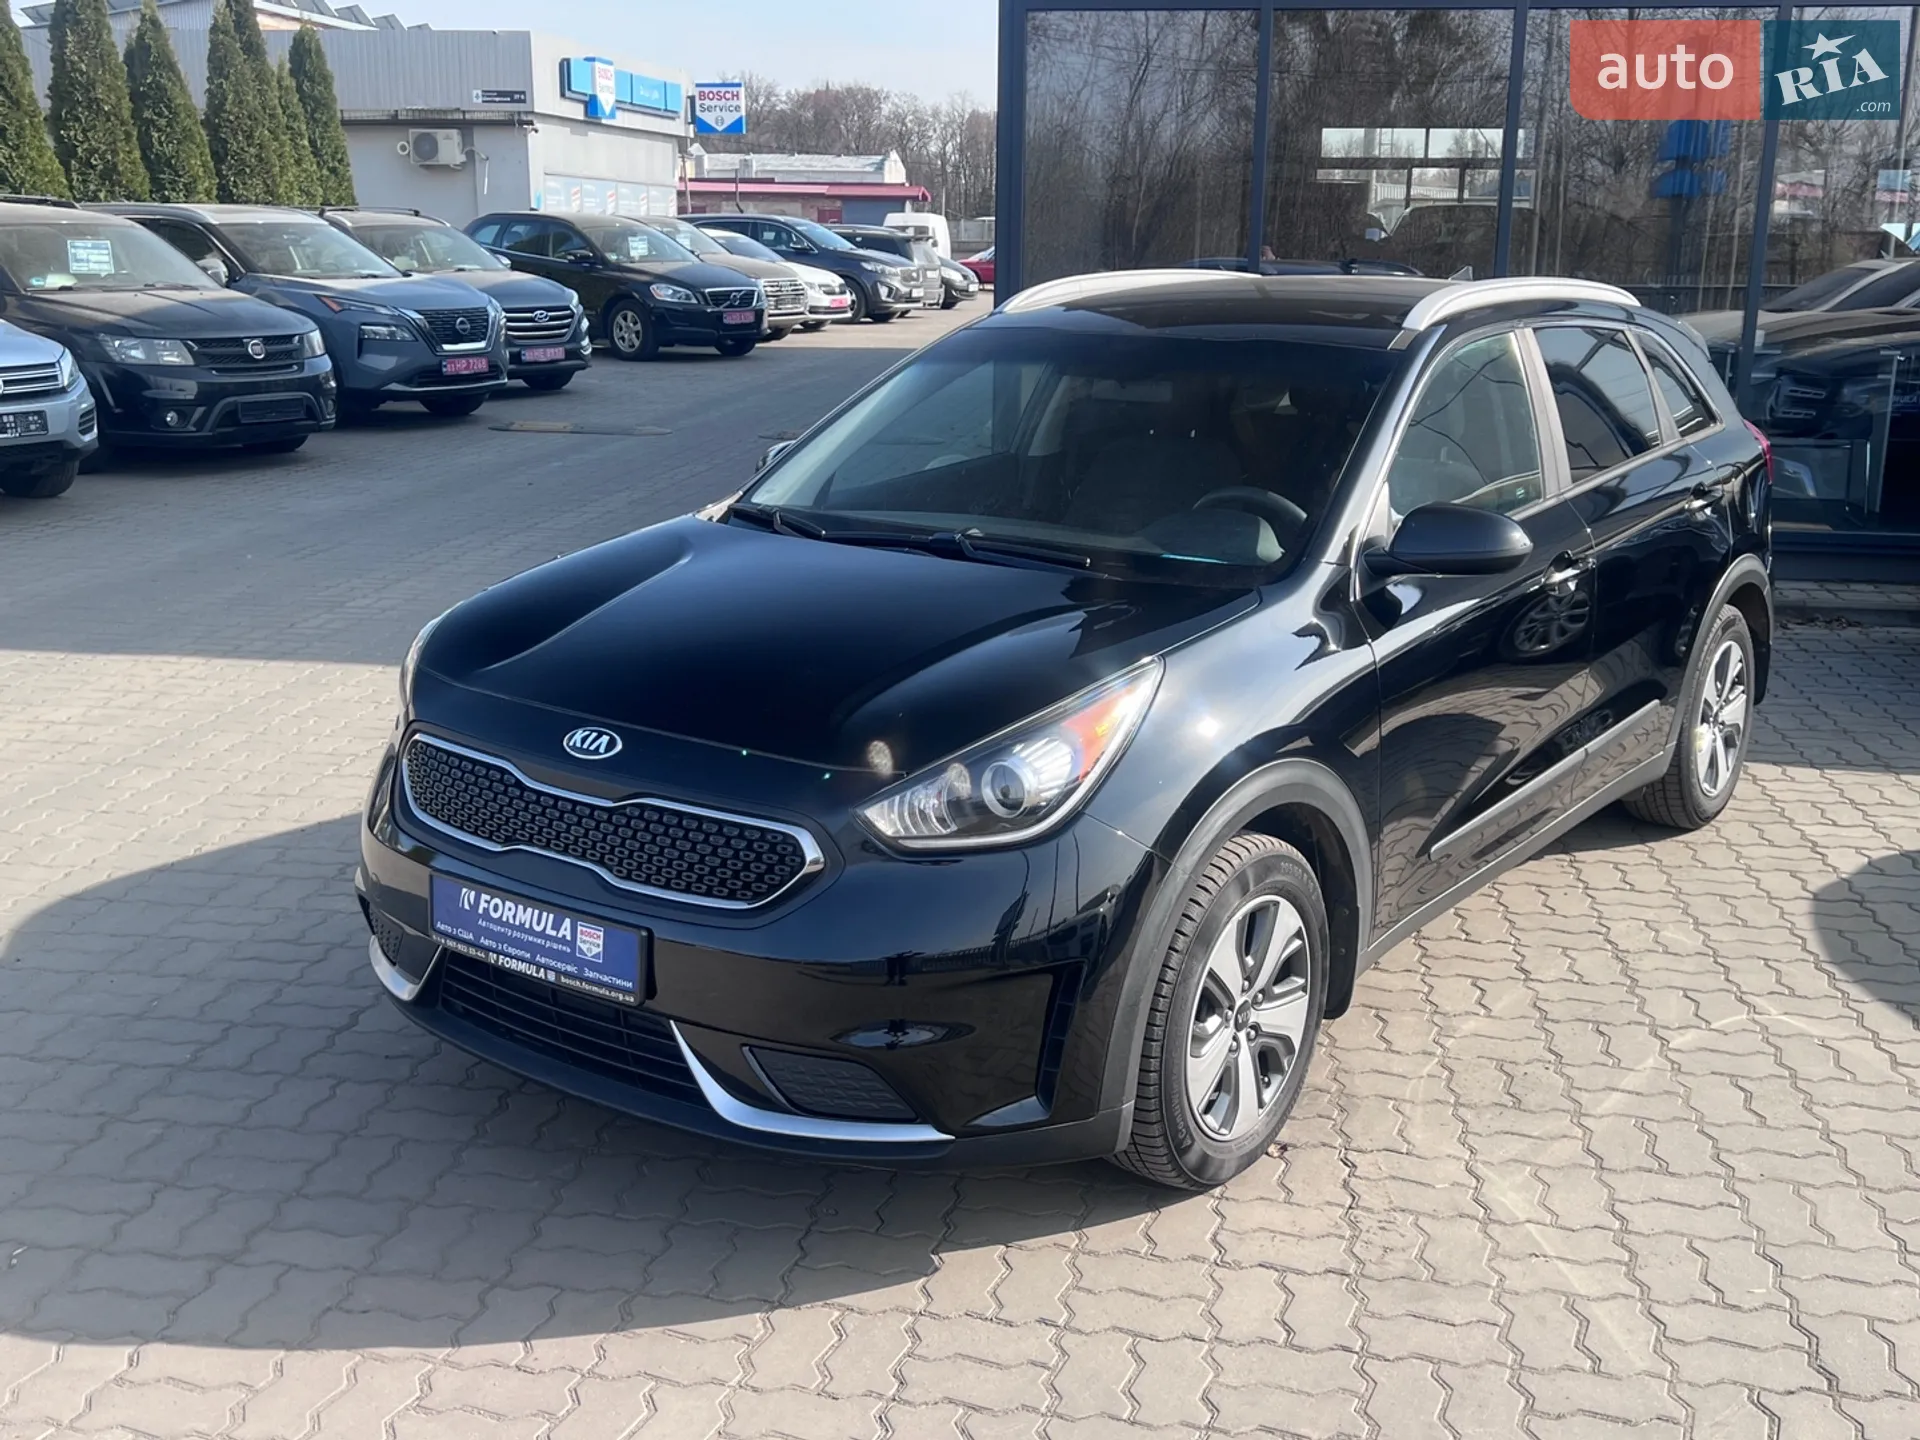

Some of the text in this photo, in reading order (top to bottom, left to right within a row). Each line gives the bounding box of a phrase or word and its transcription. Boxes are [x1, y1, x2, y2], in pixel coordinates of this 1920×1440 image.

[698, 90, 740, 101] BOSCH
[699, 103, 741, 113] Service
[568, 730, 610, 754] KIA
[478, 893, 572, 941] FORMULA
[579, 929, 601, 940] BOSCH
[436, 921, 452, 933] Авто
[457, 927, 475, 941] США
[480, 936, 497, 949] Авто
[502, 943, 531, 960] Європи
[535, 954, 579, 974] Автосервіс
[583, 967, 633, 989] Запчастини
[498, 954, 546, 980] FORMULA
